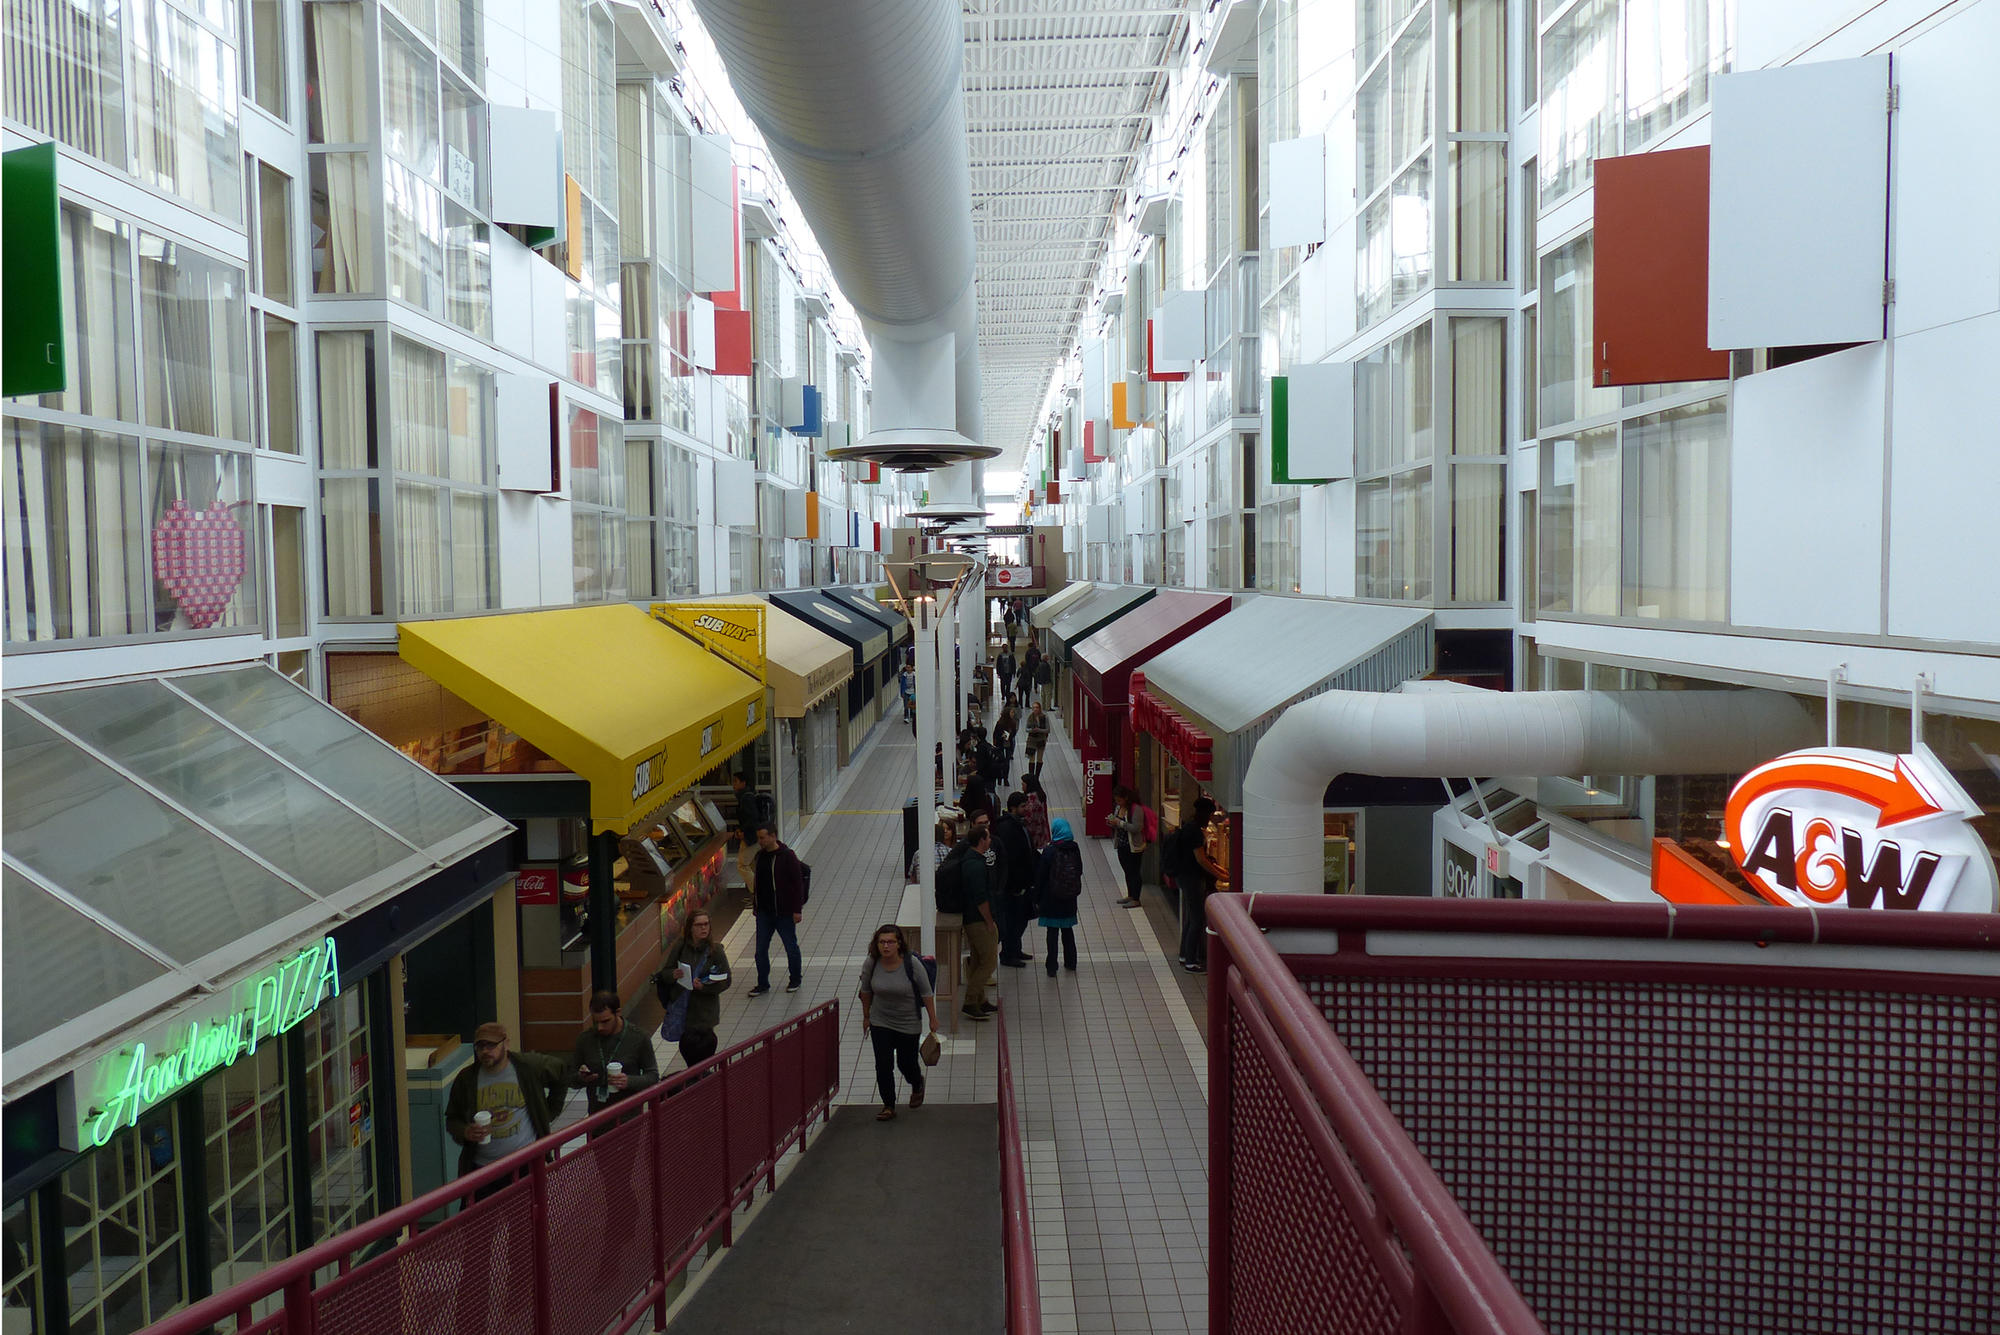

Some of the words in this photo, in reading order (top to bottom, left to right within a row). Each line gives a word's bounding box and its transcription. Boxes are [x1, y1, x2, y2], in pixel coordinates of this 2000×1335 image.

[693, 613, 757, 642] SUBWAY
[1086, 760, 1095, 805] BOOKS
[1446, 859, 1476, 899] 9014
[1742, 806, 1942, 910] A&W
[92, 1022, 246, 1147] Academy
[248, 936, 341, 1056] PIZZA
